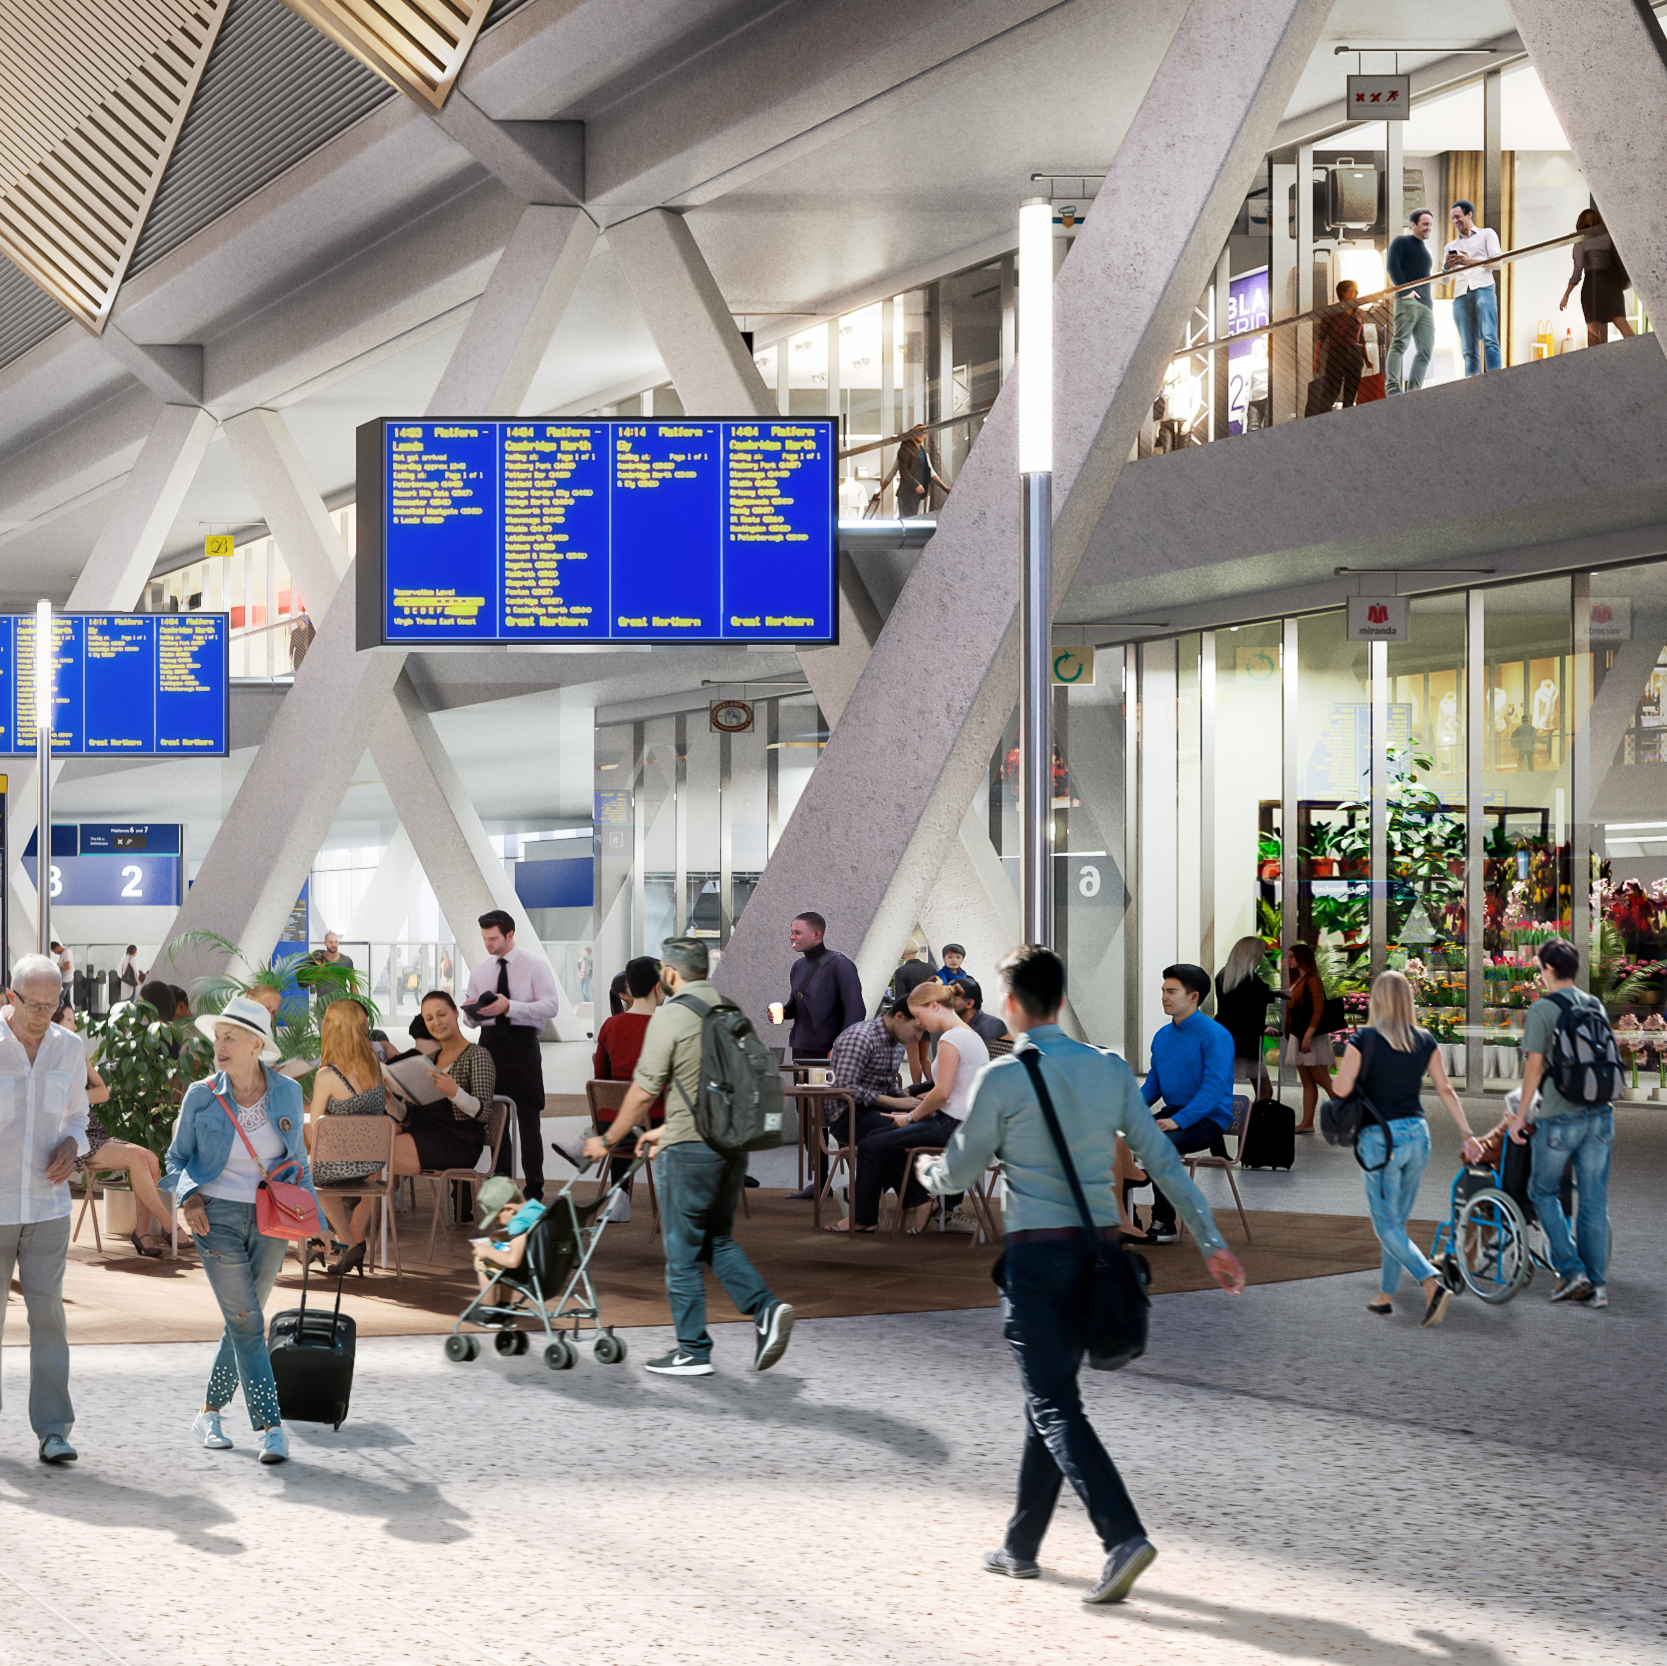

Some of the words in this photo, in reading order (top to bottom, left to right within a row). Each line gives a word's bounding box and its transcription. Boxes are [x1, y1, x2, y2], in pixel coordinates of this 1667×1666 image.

[619, 426, 648, 438] 14:14
[1359, 626, 1397, 635] miranda
[121, 866, 143, 897] 2
